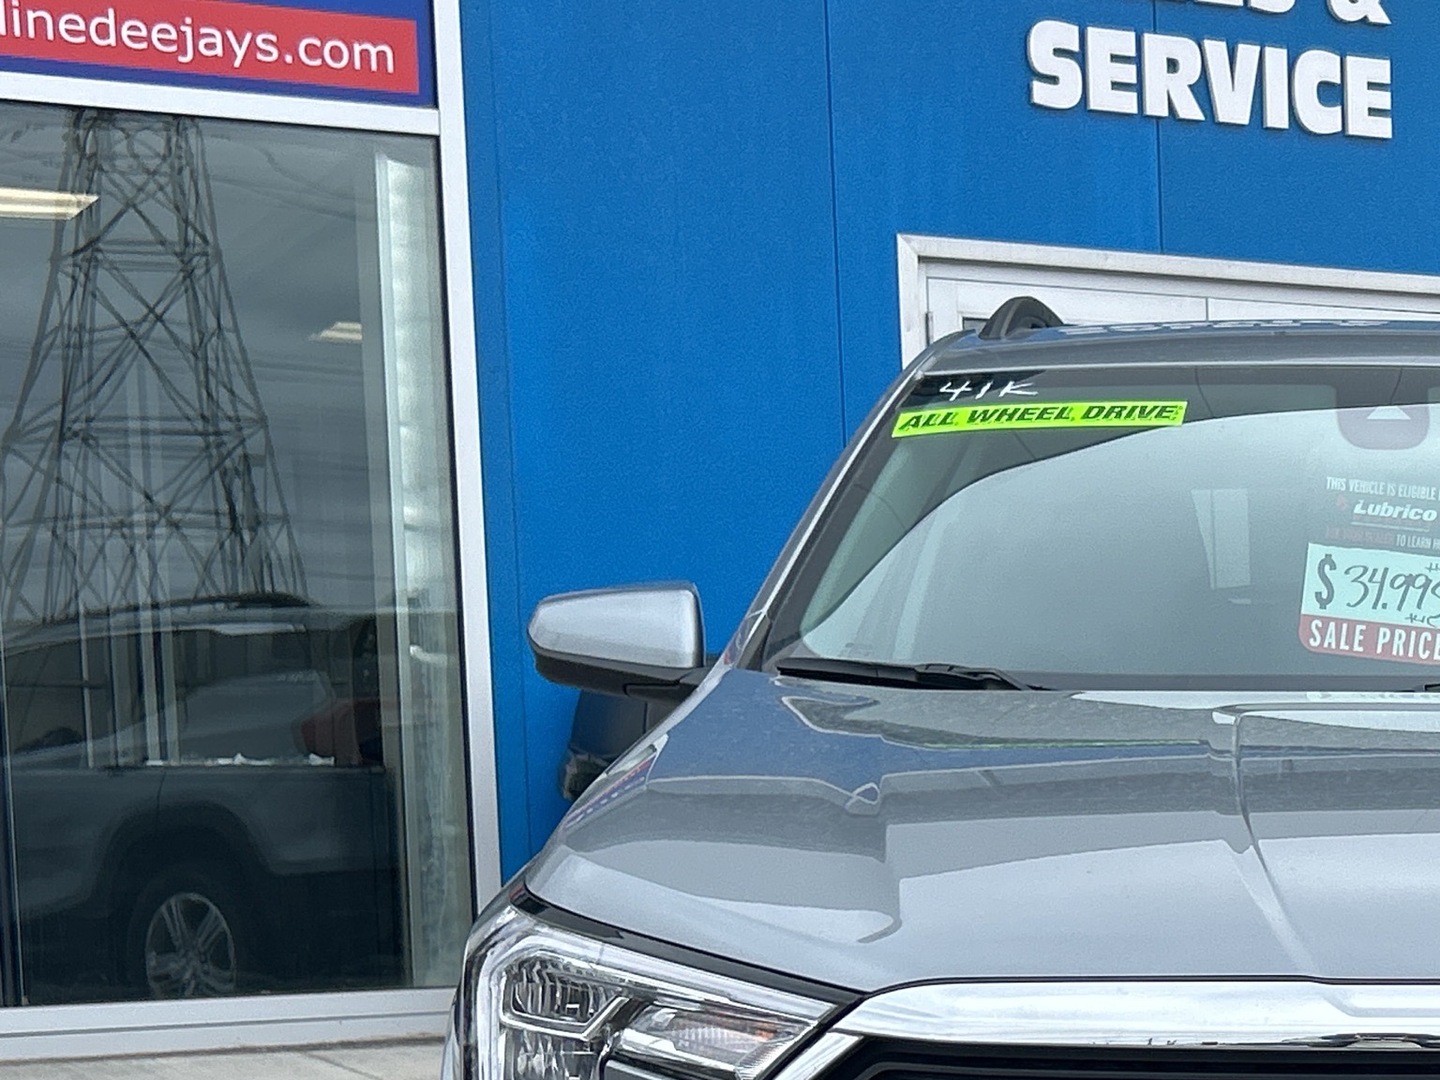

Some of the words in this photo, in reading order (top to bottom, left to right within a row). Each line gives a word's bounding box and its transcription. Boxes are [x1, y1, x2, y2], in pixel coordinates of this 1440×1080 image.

[1027, 19, 1393, 139] SERVICE
[899, 412, 958, 432] ALL
[967, 405, 1075, 424] WHEEL
[1080, 404, 1183, 420] DRIVE
[1326, 476, 1346, 491] THIS
[1348, 479, 1385, 495] VEHICLE
[1387, 483, 1396, 497] IS
[1398, 484, 1436, 500] ELIGIBLE
[1353, 500, 1438, 522] Lubrico
[1396, 534, 1406, 546] TO
[1407, 536, 1432, 549] LEARN
[1309, 619, 1367, 652] SALE
